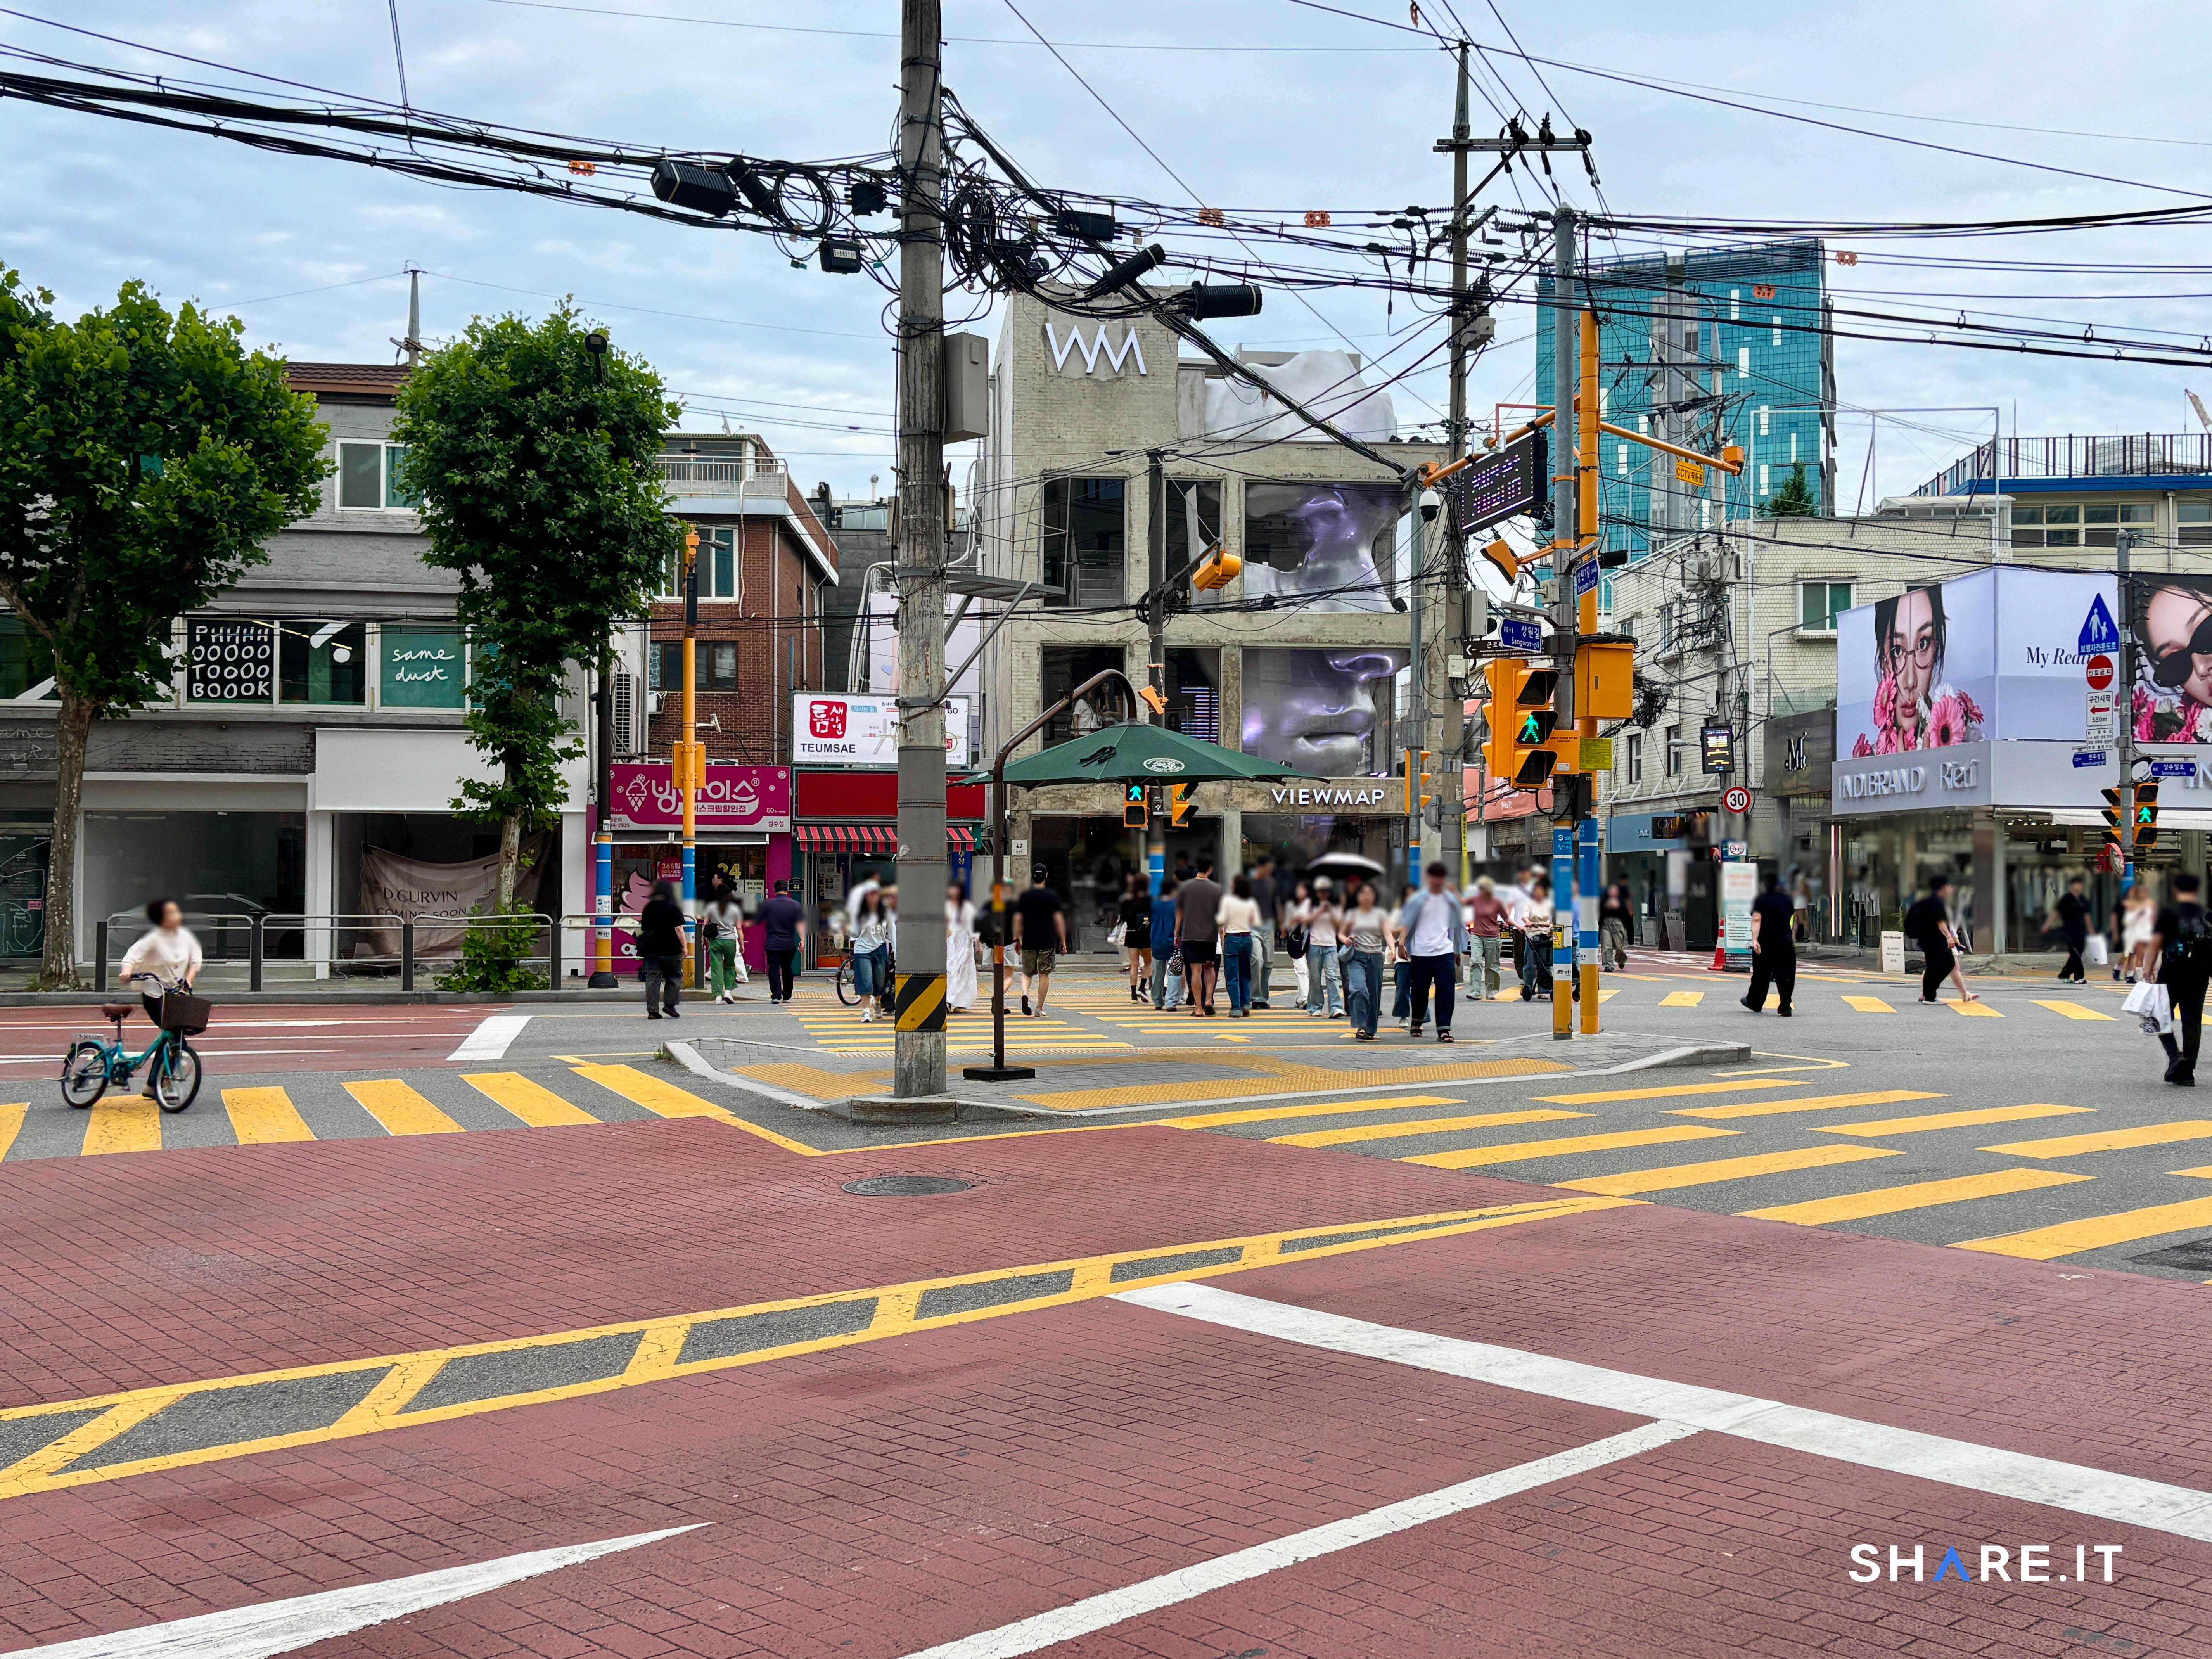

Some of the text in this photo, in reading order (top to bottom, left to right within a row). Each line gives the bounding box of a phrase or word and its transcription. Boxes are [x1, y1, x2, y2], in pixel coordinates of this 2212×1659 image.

[1521, 625, 1539, 639] 상원길
[2080, 642, 2117, 653] 보행자전용도로
[392, 649, 455, 662] same
[2027, 647, 2049, 668] My
[396, 665, 448, 682] dust
[193, 681, 270, 699] BOOOK
[2089, 695, 2111, 703] 구간시작
[801, 743, 856, 753] TEUMSAE
[1838, 766, 1926, 799] INDIBRAND
[1271, 788, 1384, 805] VIEWMAP
[1730, 792, 1744, 806] 30
[384, 887, 458, 903] D.CURVIN
[433, 907, 467, 917] SOON
